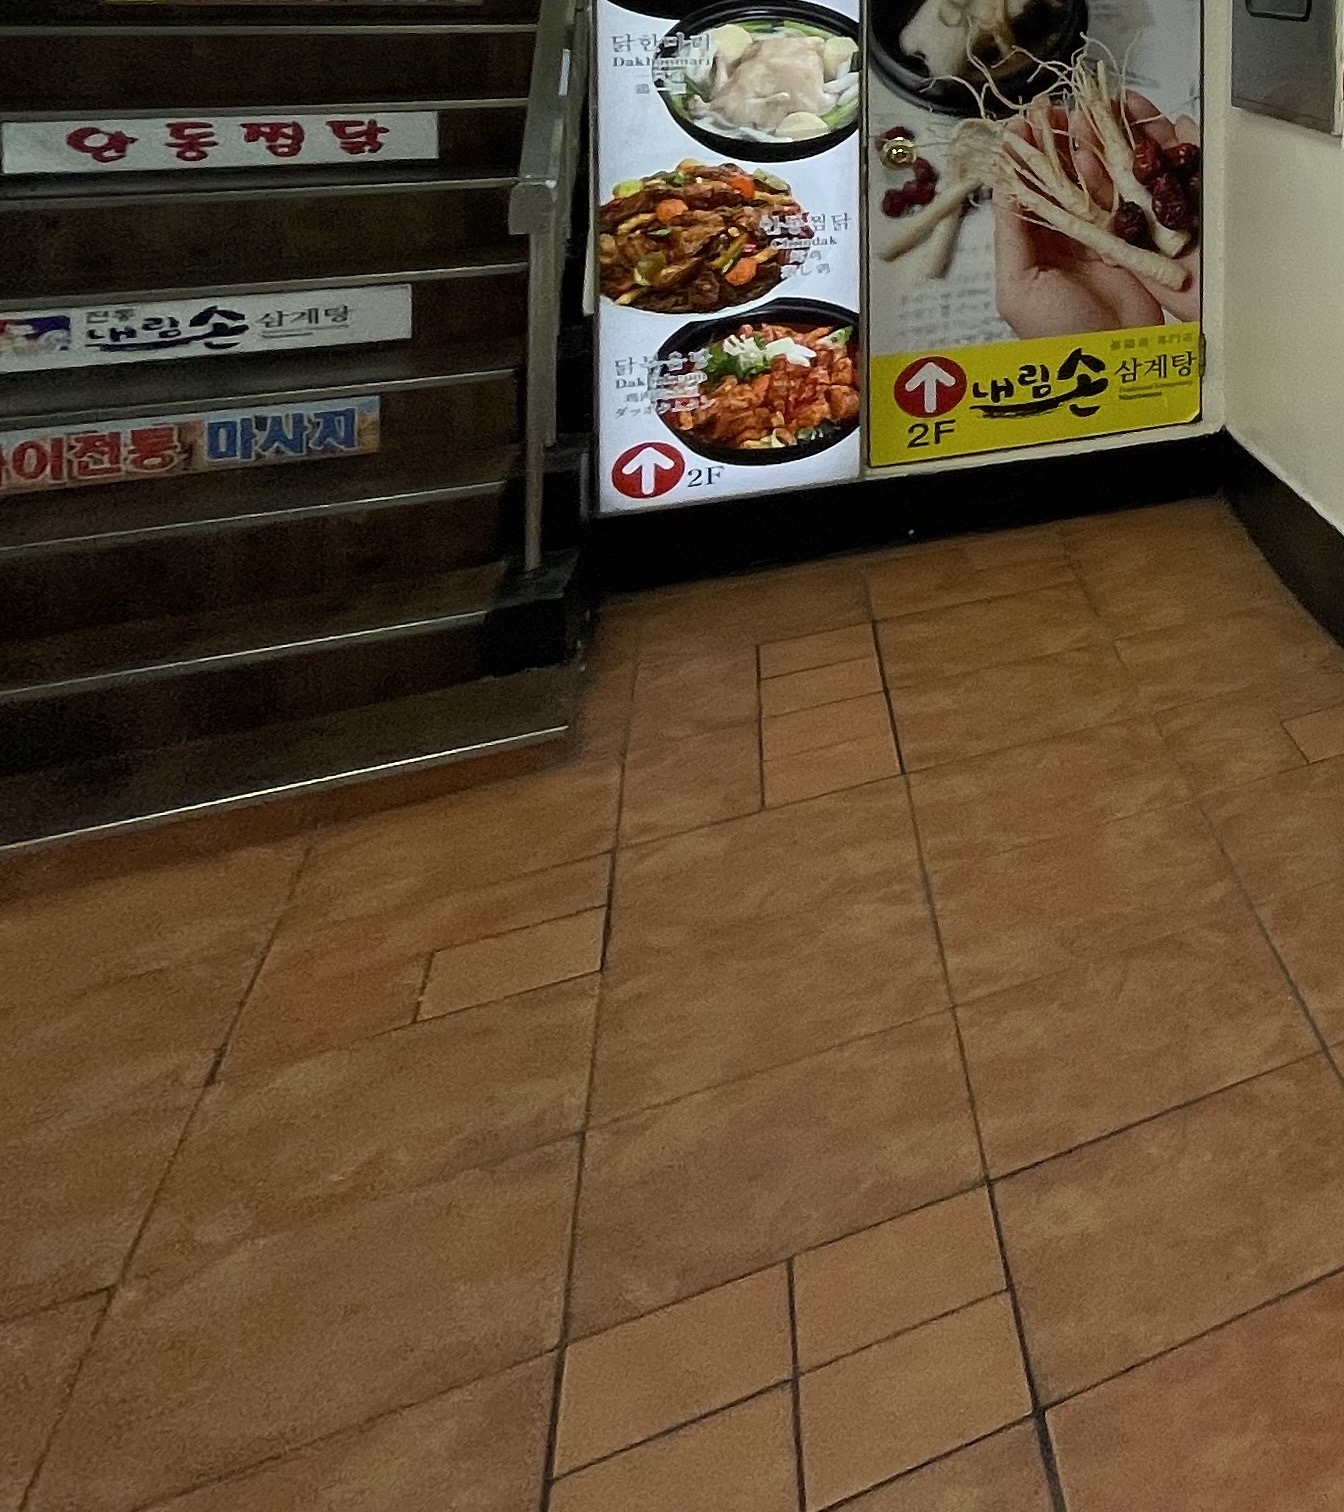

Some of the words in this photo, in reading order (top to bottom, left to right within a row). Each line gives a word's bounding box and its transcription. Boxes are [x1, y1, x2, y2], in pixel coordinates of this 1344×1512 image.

[66, 119, 391, 163] 안동찜닭
[970, 348, 1109, 418] 내림손
[1115, 351, 1197, 383] 삼계탕
[0, 426, 181, 482] 이전통
[205, 407, 359, 460] 마사지
[908, 419, 957, 449] 2F
[687, 465, 726, 487] 2F
